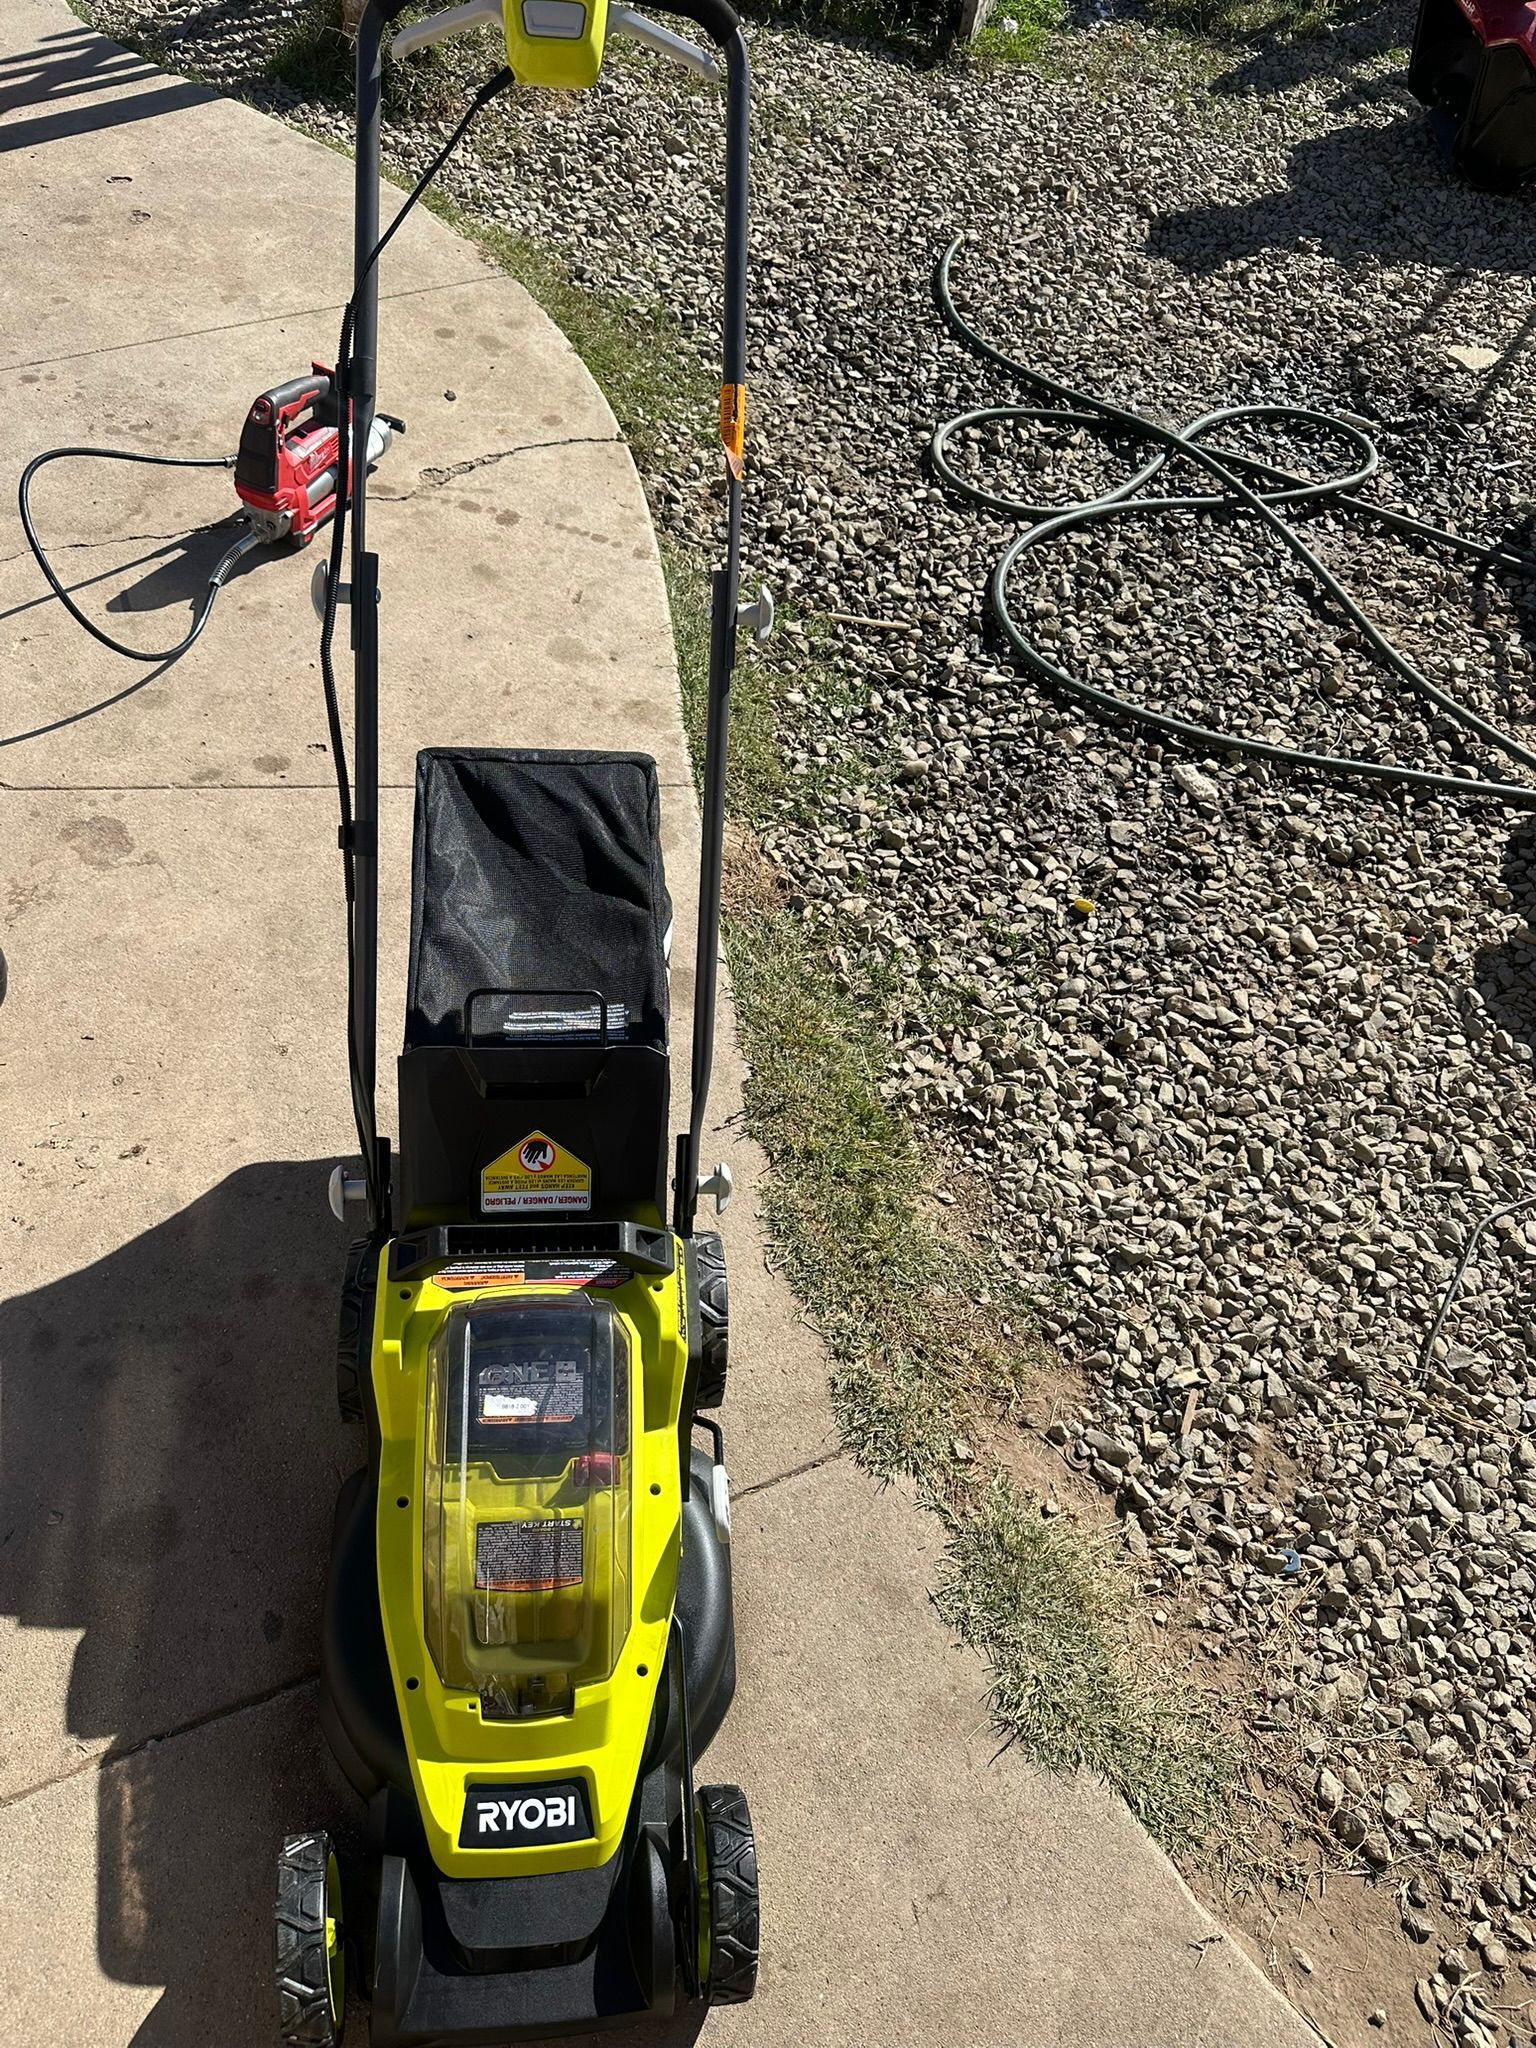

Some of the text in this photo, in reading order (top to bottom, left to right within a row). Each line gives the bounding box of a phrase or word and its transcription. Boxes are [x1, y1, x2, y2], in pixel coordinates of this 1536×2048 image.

[485, 1197, 517, 1206] PELIGRO
[522, 1196, 553, 1205] DANGER
[558, 1195, 588, 1204] DANGER
[521, 1519, 572, 1529] START KEY
[476, 1796, 576, 1833] RYOBI
